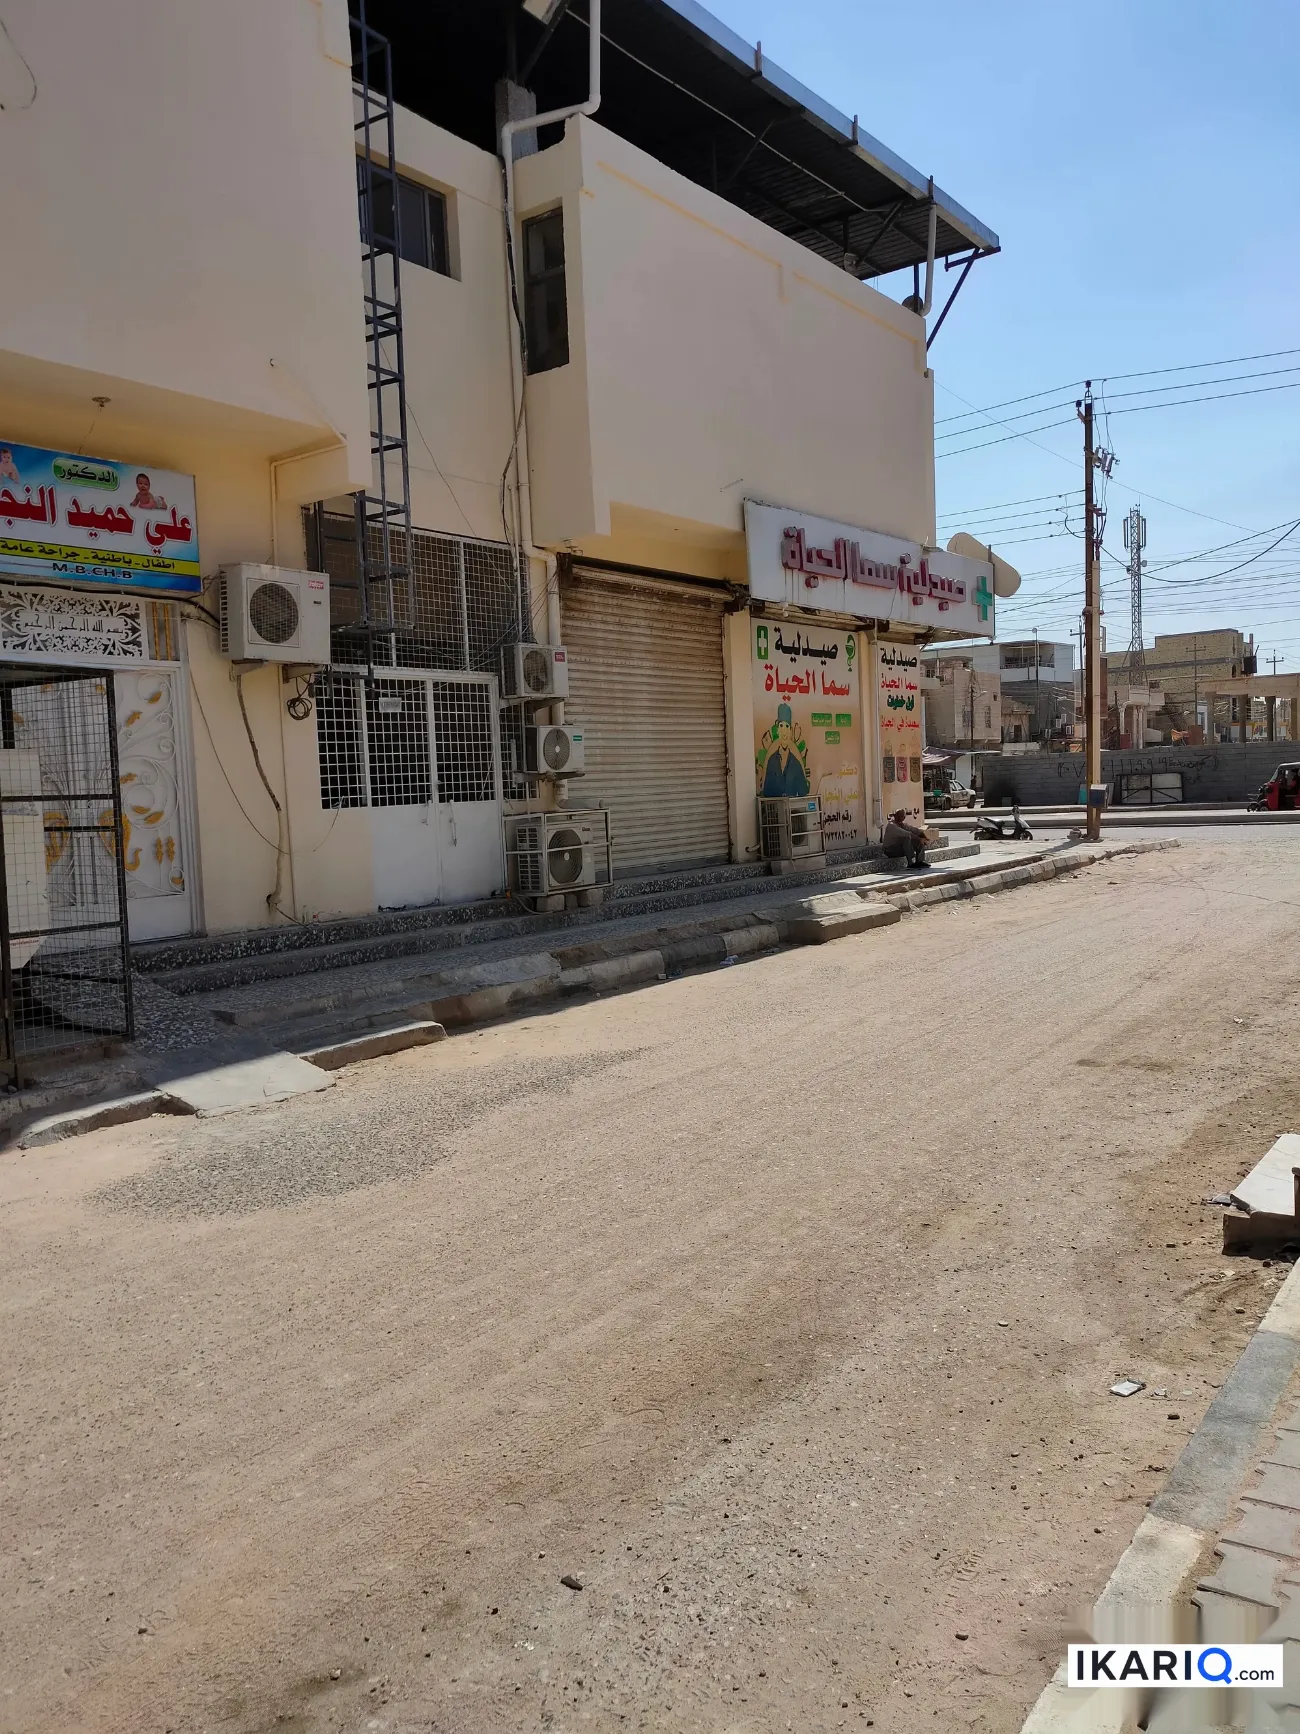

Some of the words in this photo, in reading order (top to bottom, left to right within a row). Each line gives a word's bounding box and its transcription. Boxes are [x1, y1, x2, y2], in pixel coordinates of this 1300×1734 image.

[59, 464, 116, 484] الدكتور
[67, 498, 134, 538] حميد
[146, 506, 192, 554] علي
[38, 544, 80, 559] جراحة
[91, 551, 132, 565] باطنية
[781, 526, 850, 588] الحياة
[142, 559, 175, 569] اطفال
[852, 541, 897, 589] سما
[92, 619, 103, 633] الله
[774, 625, 839, 665] صيدلية
[880, 646, 918, 672] صيدلية
[764, 663, 816, 701] الحياة
[821, 671, 850, 696] سما
[881, 673, 903, 692] الحياة
[905, 677, 918, 691] سما
[841, 810, 852, 824] رقم
